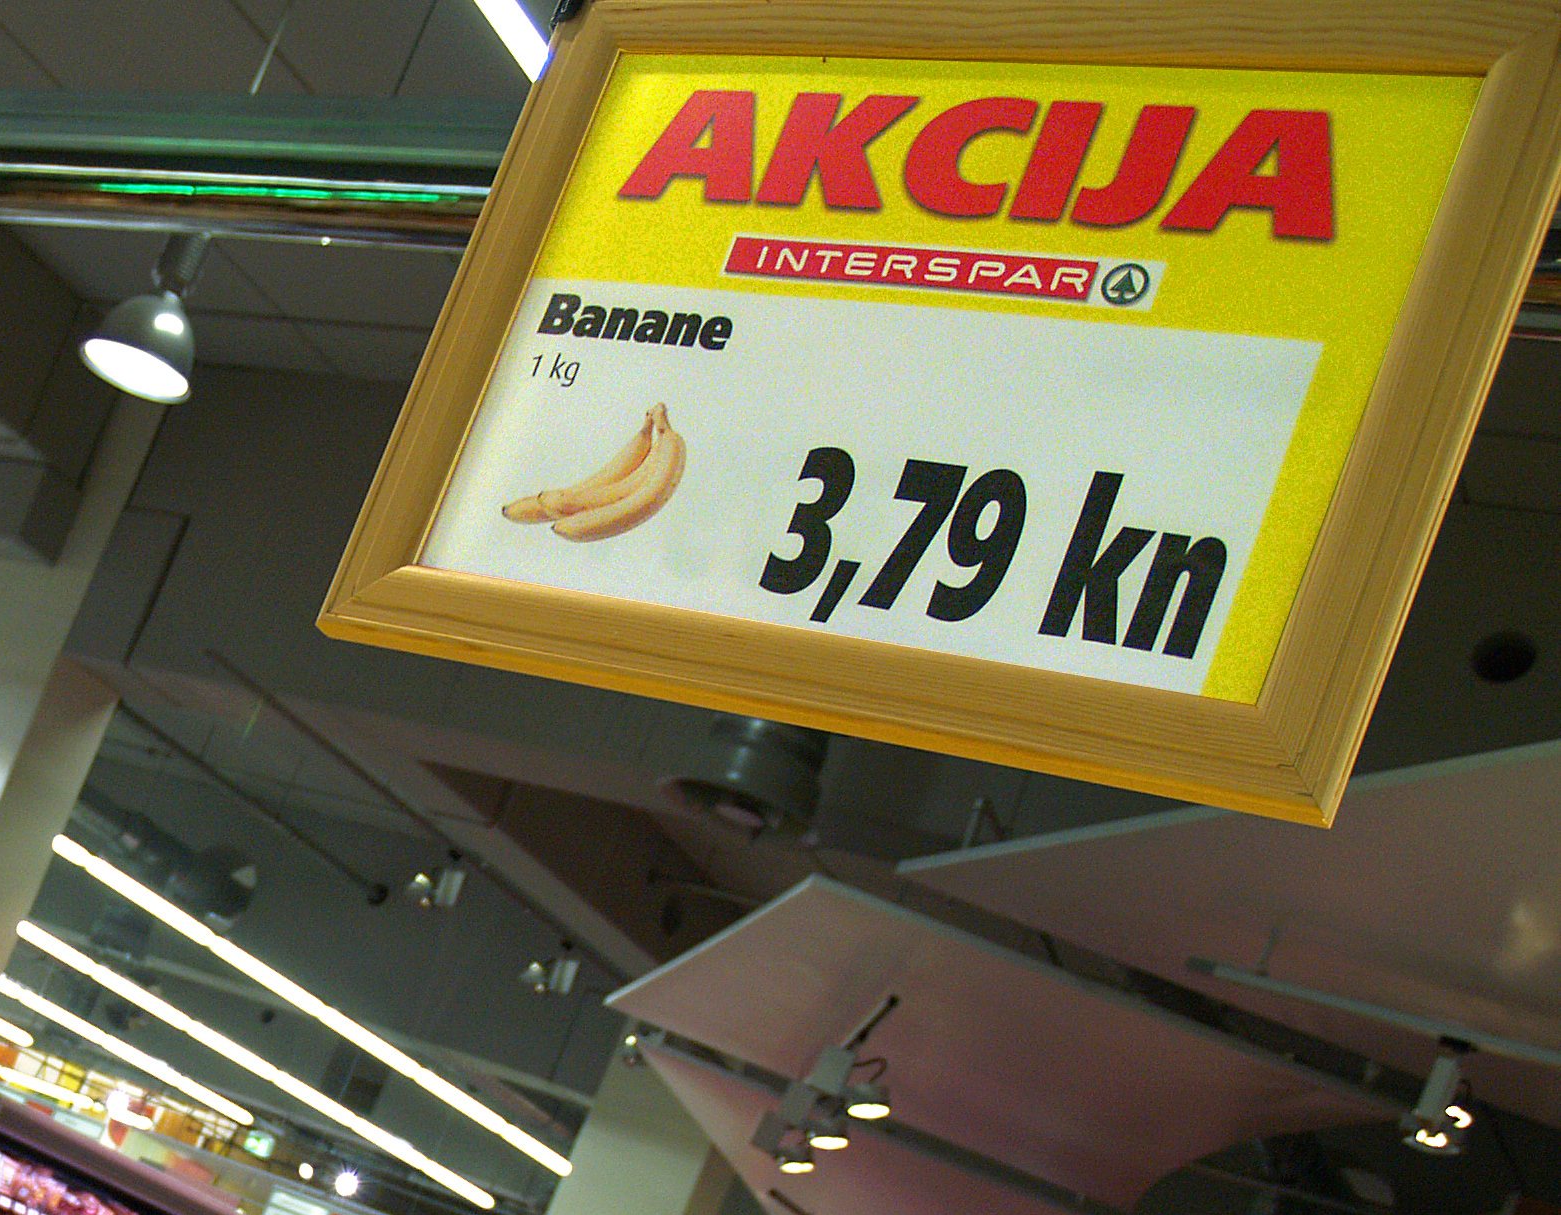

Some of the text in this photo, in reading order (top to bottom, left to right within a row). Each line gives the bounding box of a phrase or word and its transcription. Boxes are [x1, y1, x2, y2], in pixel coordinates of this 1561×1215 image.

[617, 89, 1335, 241] AKCIJA
[755, 246, 1090, 295] INTERSPAR
[537, 293, 732, 351] Banane
[530, 353, 580, 386] 1 kg
[759, 447, 1228, 660] 3,79 kn
